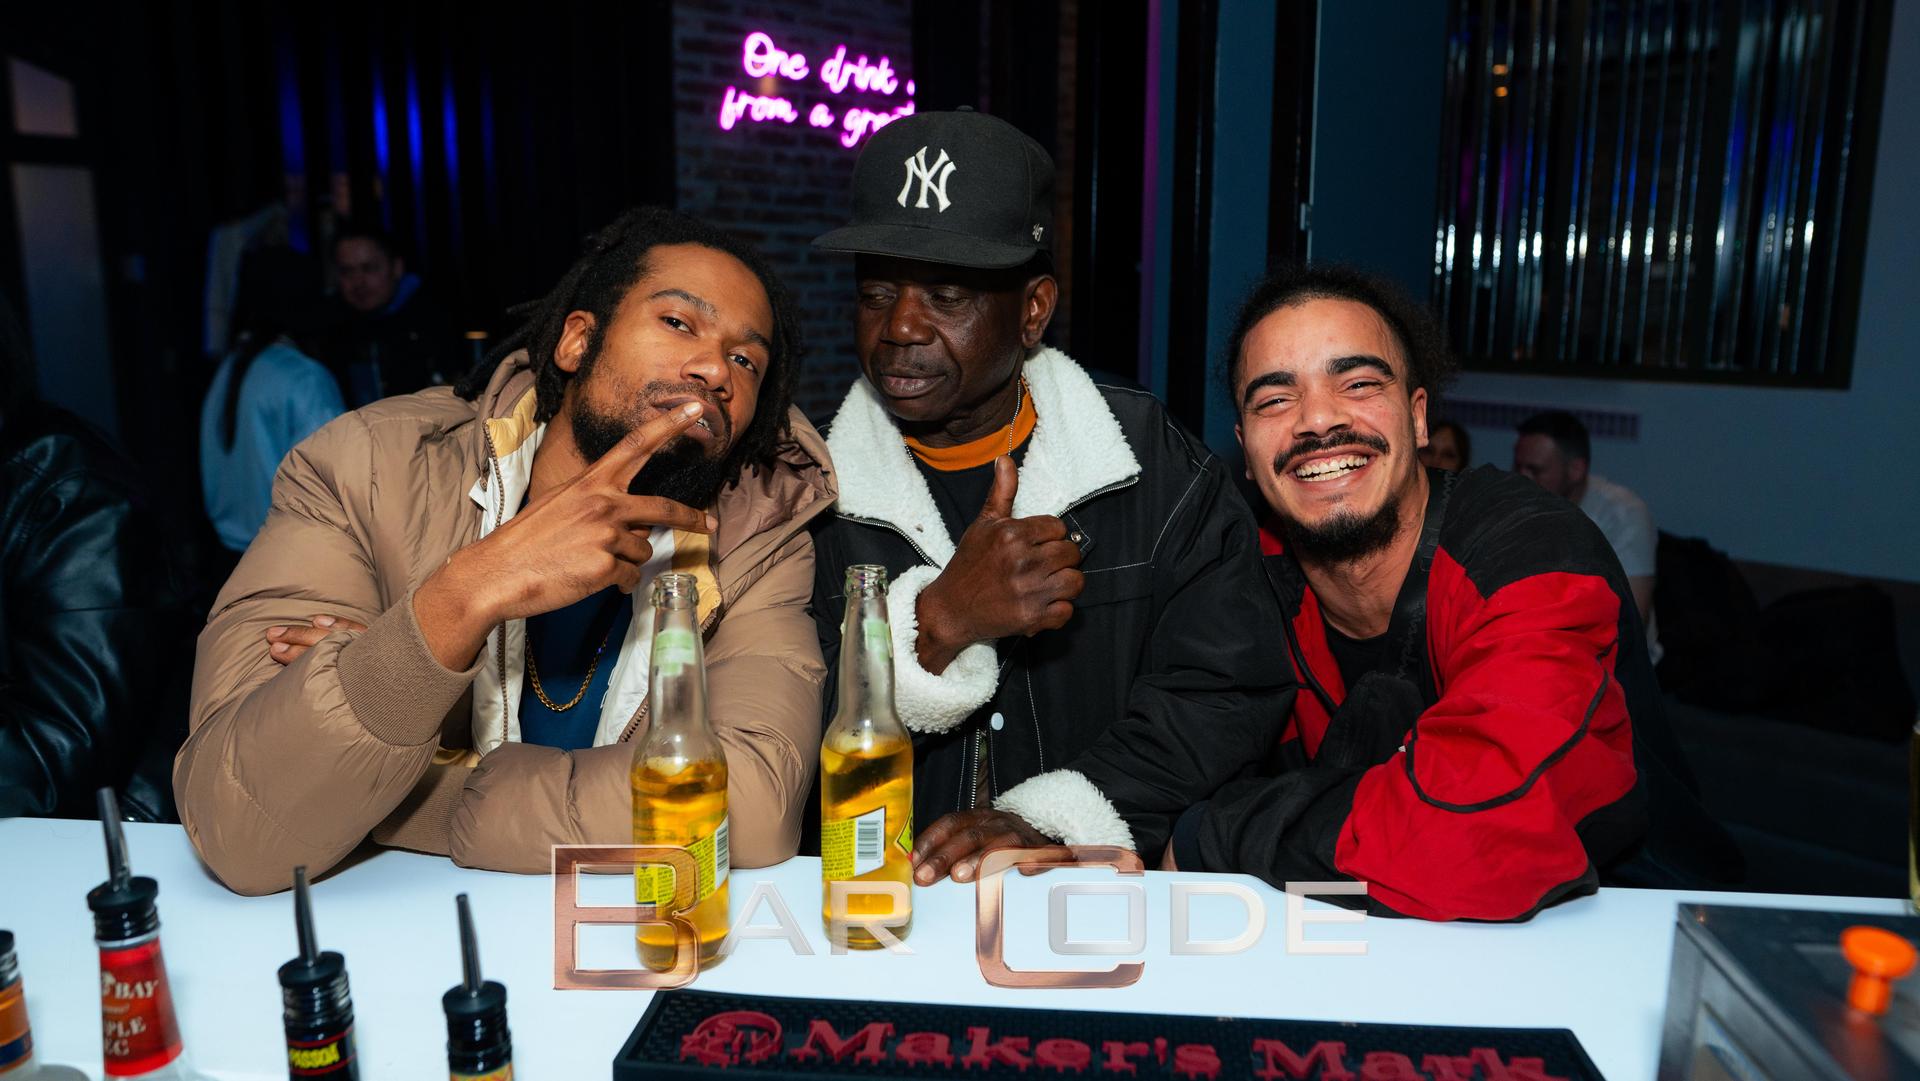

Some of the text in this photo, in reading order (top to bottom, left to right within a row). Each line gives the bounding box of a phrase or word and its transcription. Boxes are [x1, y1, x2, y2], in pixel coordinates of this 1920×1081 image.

[743, 31, 809, 80] One
[719, 86, 798, 131] from
[809, 103, 835, 128] a
[789, 1019, 1570, 1081] Maker's Mark
